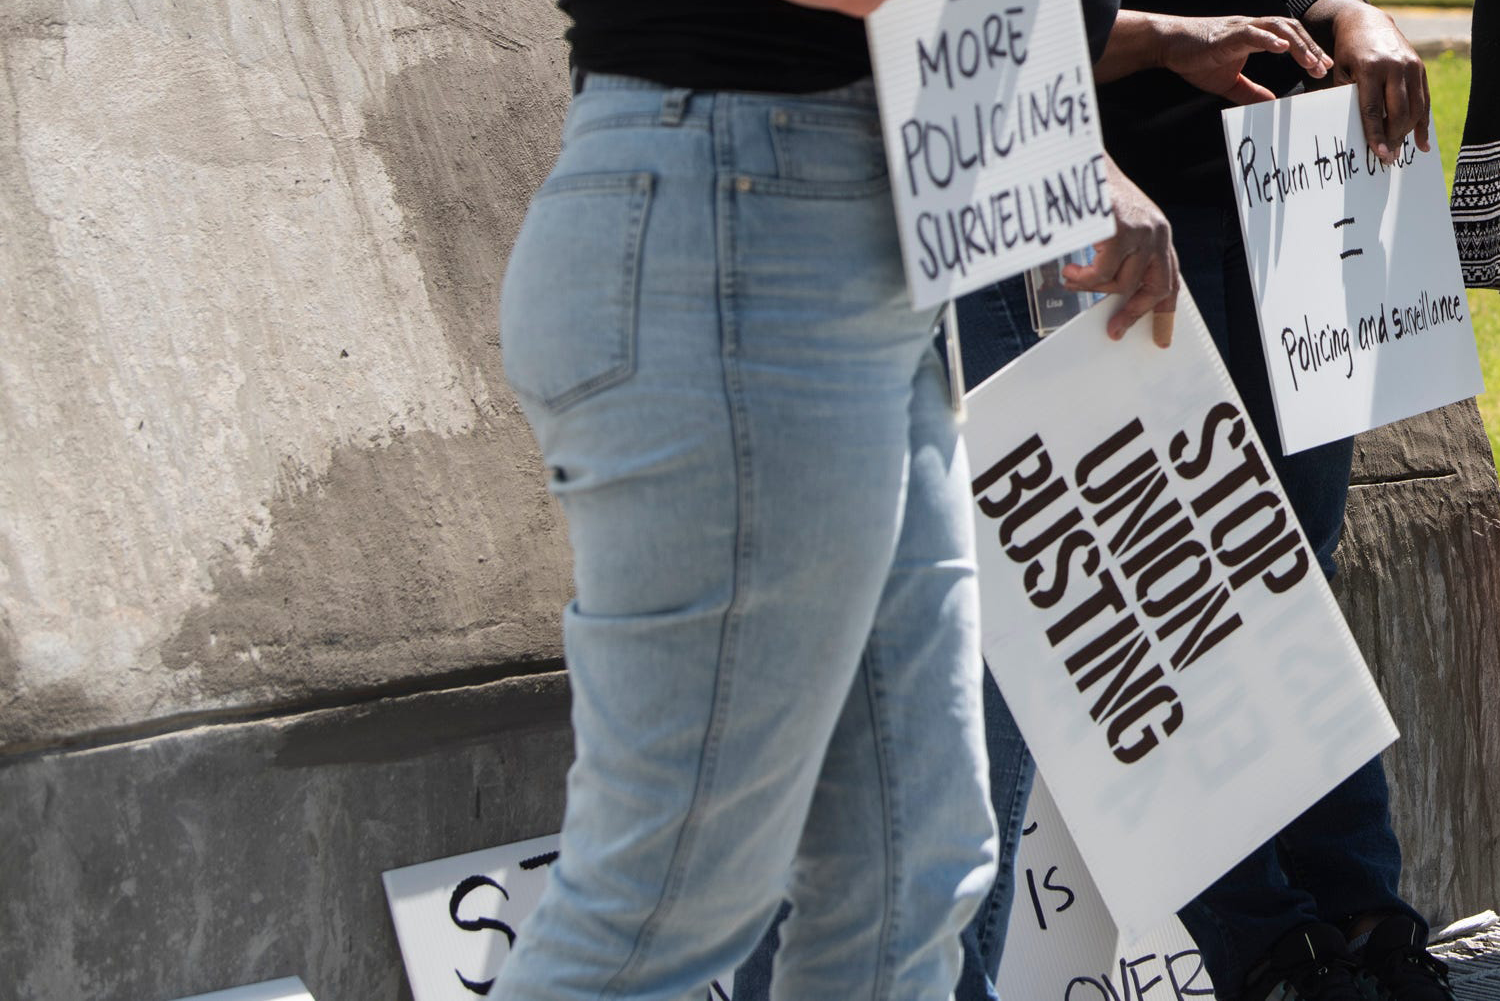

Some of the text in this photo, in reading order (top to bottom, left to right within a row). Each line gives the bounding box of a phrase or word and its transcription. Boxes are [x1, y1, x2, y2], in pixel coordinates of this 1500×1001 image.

[917, 8, 1028, 90] MORE
[902, 73, 1074, 197] POLICING
[1237, 136, 1309, 208] Return
[1315, 135, 1333, 190] to
[1334, 135, 1359, 185] the
[916, 154, 1114, 280] SURVELLANCE
[1281, 290, 1463, 391] Policing and surveillance
[1075, 416, 1243, 673] UNION
[1169, 402, 1310, 594] STOP
[971, 433, 1184, 764] BUSTING
[1026, 866, 1075, 930] IS
